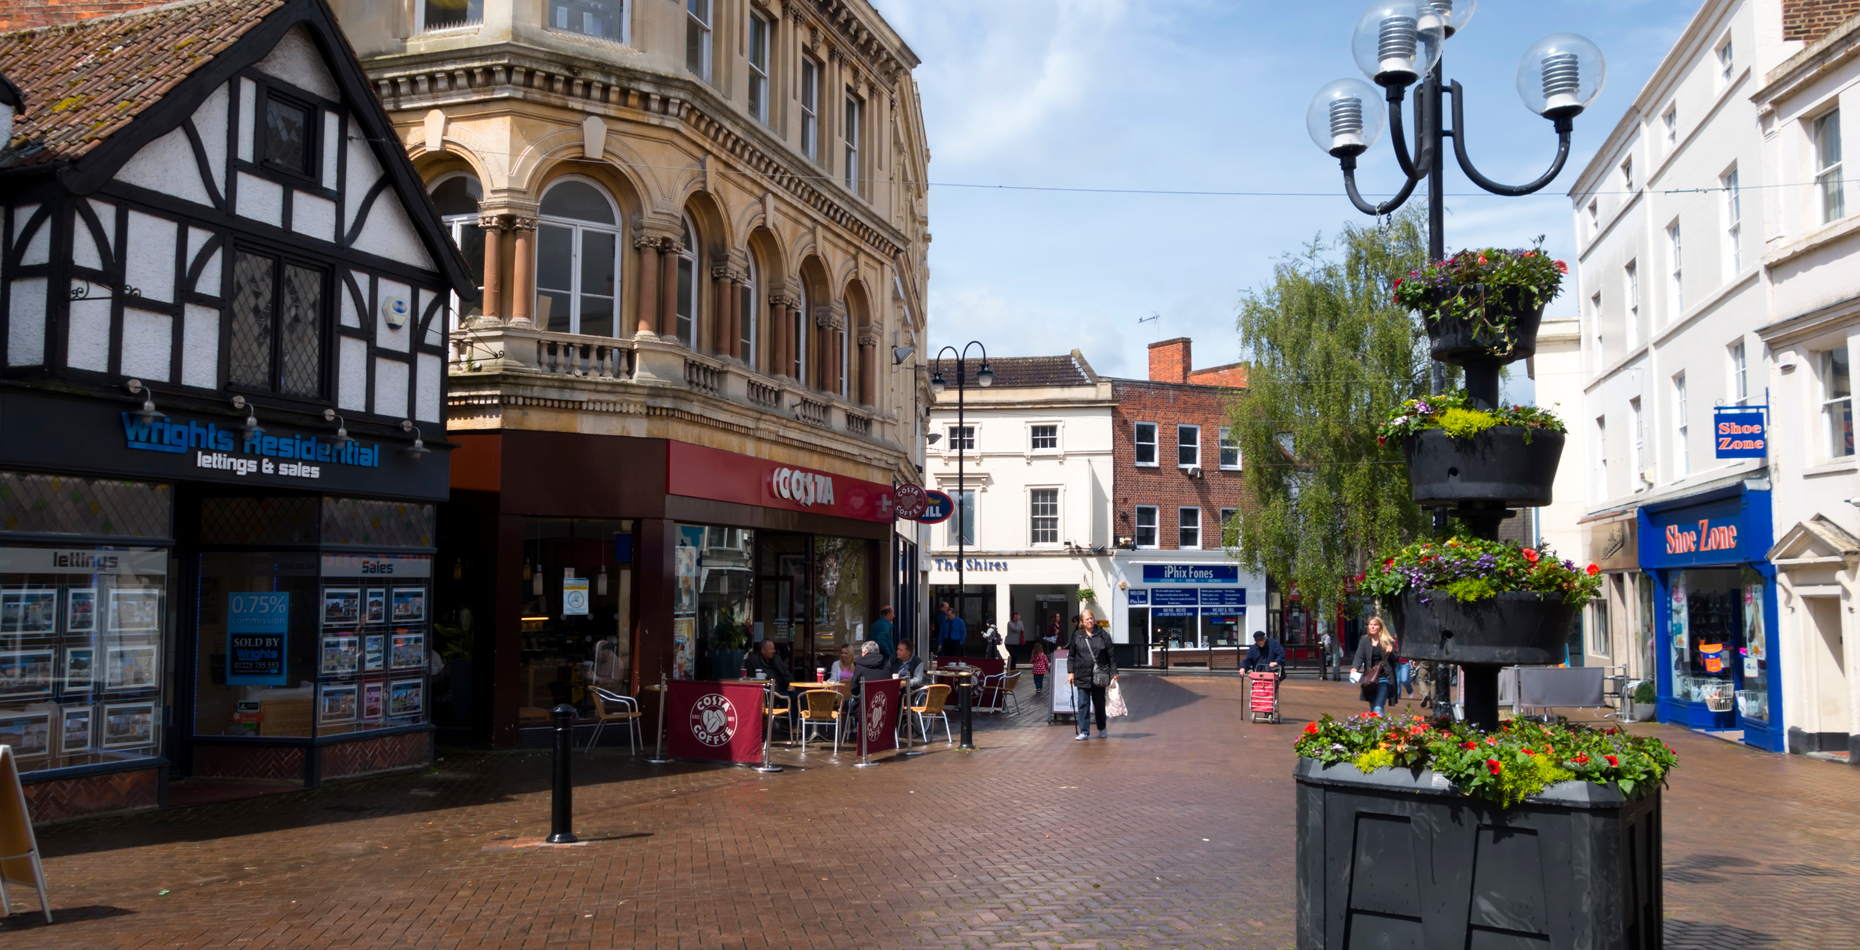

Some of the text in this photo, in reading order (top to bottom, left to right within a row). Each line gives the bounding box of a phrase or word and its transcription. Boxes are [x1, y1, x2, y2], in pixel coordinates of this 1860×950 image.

[1718, 422, 1762, 435] Shoe
[120, 411, 379, 467] Wrights Residential
[1718, 437, 1764, 450] Zone
[197, 451, 320, 478] lettings & sales
[773, 467, 835, 507] COSTA
[897, 487, 919, 497] COSTA
[896, 504, 922, 516] COFFEE
[921, 506, 942, 518] ILL
[1665, 519, 1738, 554] Shoe Zone
[53, 552, 118, 571] lettings
[966, 558, 1008, 571] Shires
[1164, 566, 1213, 579] iPhix Fones
[231, 595, 286, 614] 0.75%
[232, 617, 285, 625] commission
[234, 638, 280, 647] SOLD BY
[236, 648, 278, 661] Wrights
[697, 695, 729, 712] COSTA
[871, 692, 886, 708] COSTA
[693, 724, 733, 745] COFFEE
[867, 722, 884, 740] COFFEE
